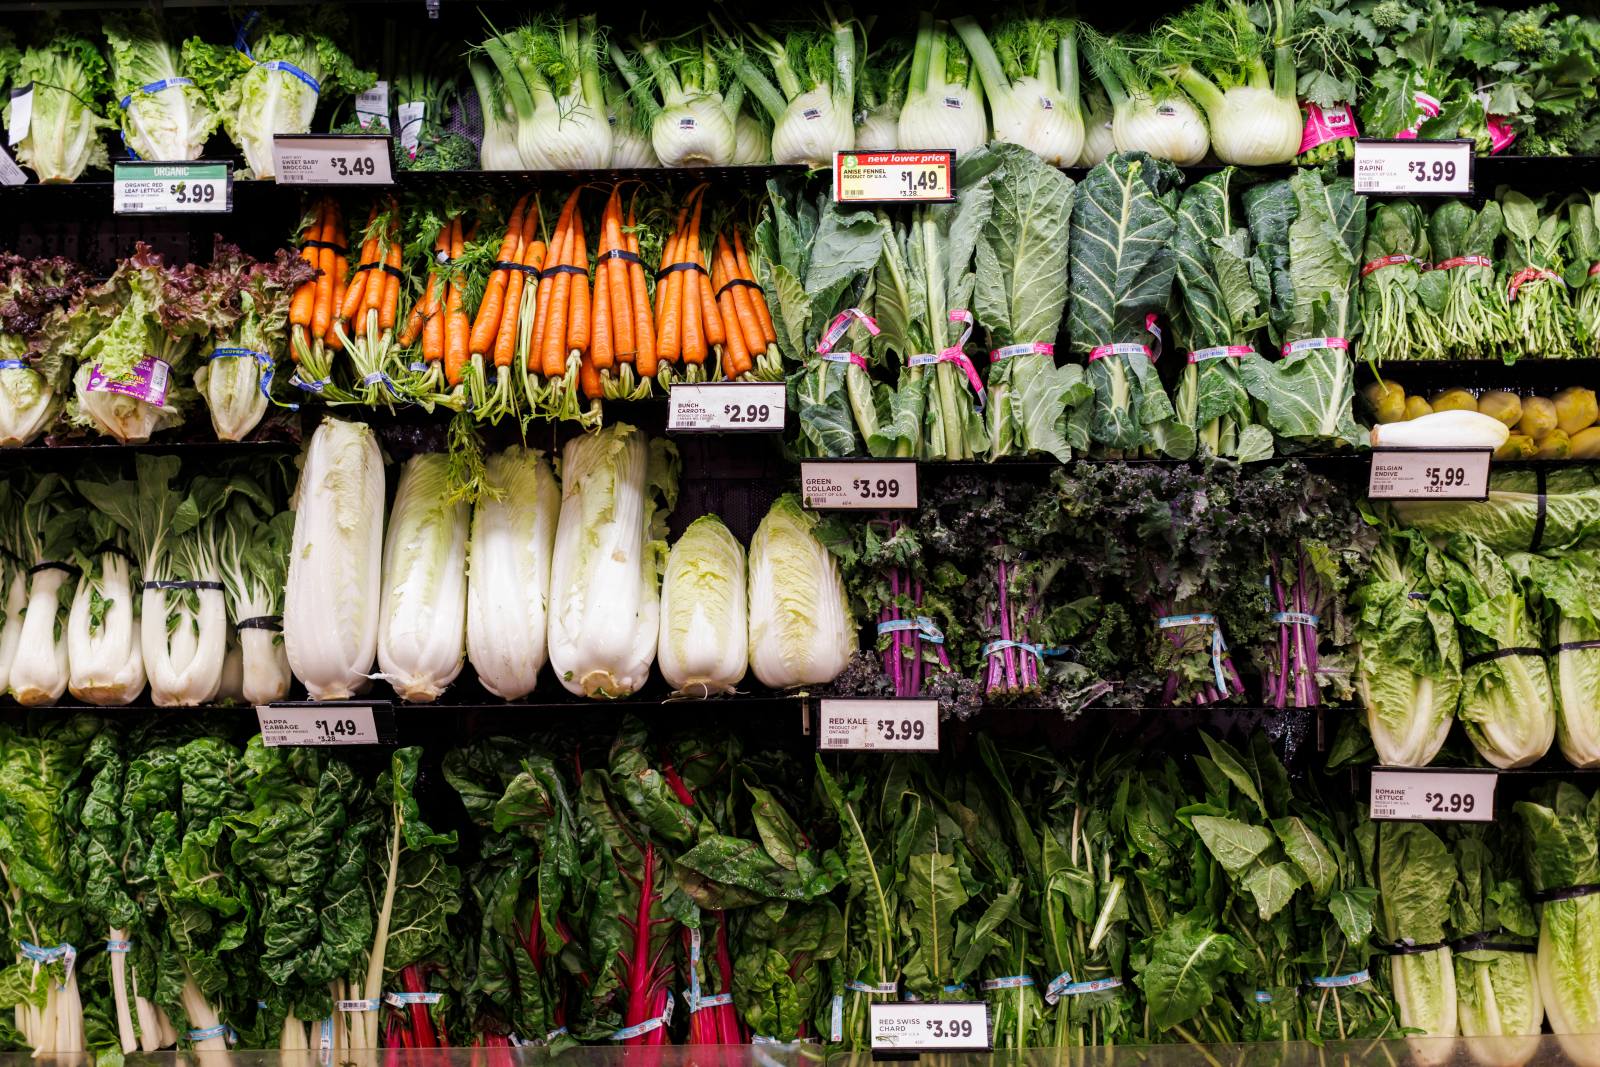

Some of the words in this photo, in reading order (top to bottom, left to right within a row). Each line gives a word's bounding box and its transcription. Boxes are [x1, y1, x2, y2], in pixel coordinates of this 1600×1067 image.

[330, 157, 375, 176] $3.49
[920, 154, 946, 163] price
[154, 167, 190, 176] ORGANIC
[901, 171, 938, 190] $1.49
[1408, 161, 1456, 182] $3.99
[170, 184, 215, 204] $3.99
[724, 404, 770, 422] $2.99
[1426, 468, 1465, 486] $5.99
[853, 479, 900, 498] $3.99
[316, 720, 356, 736] $1.49
[878, 720, 924, 740] $3.99
[1426, 792, 1474, 813] $2.99
[926, 1020, 972, 1037] $3.99
